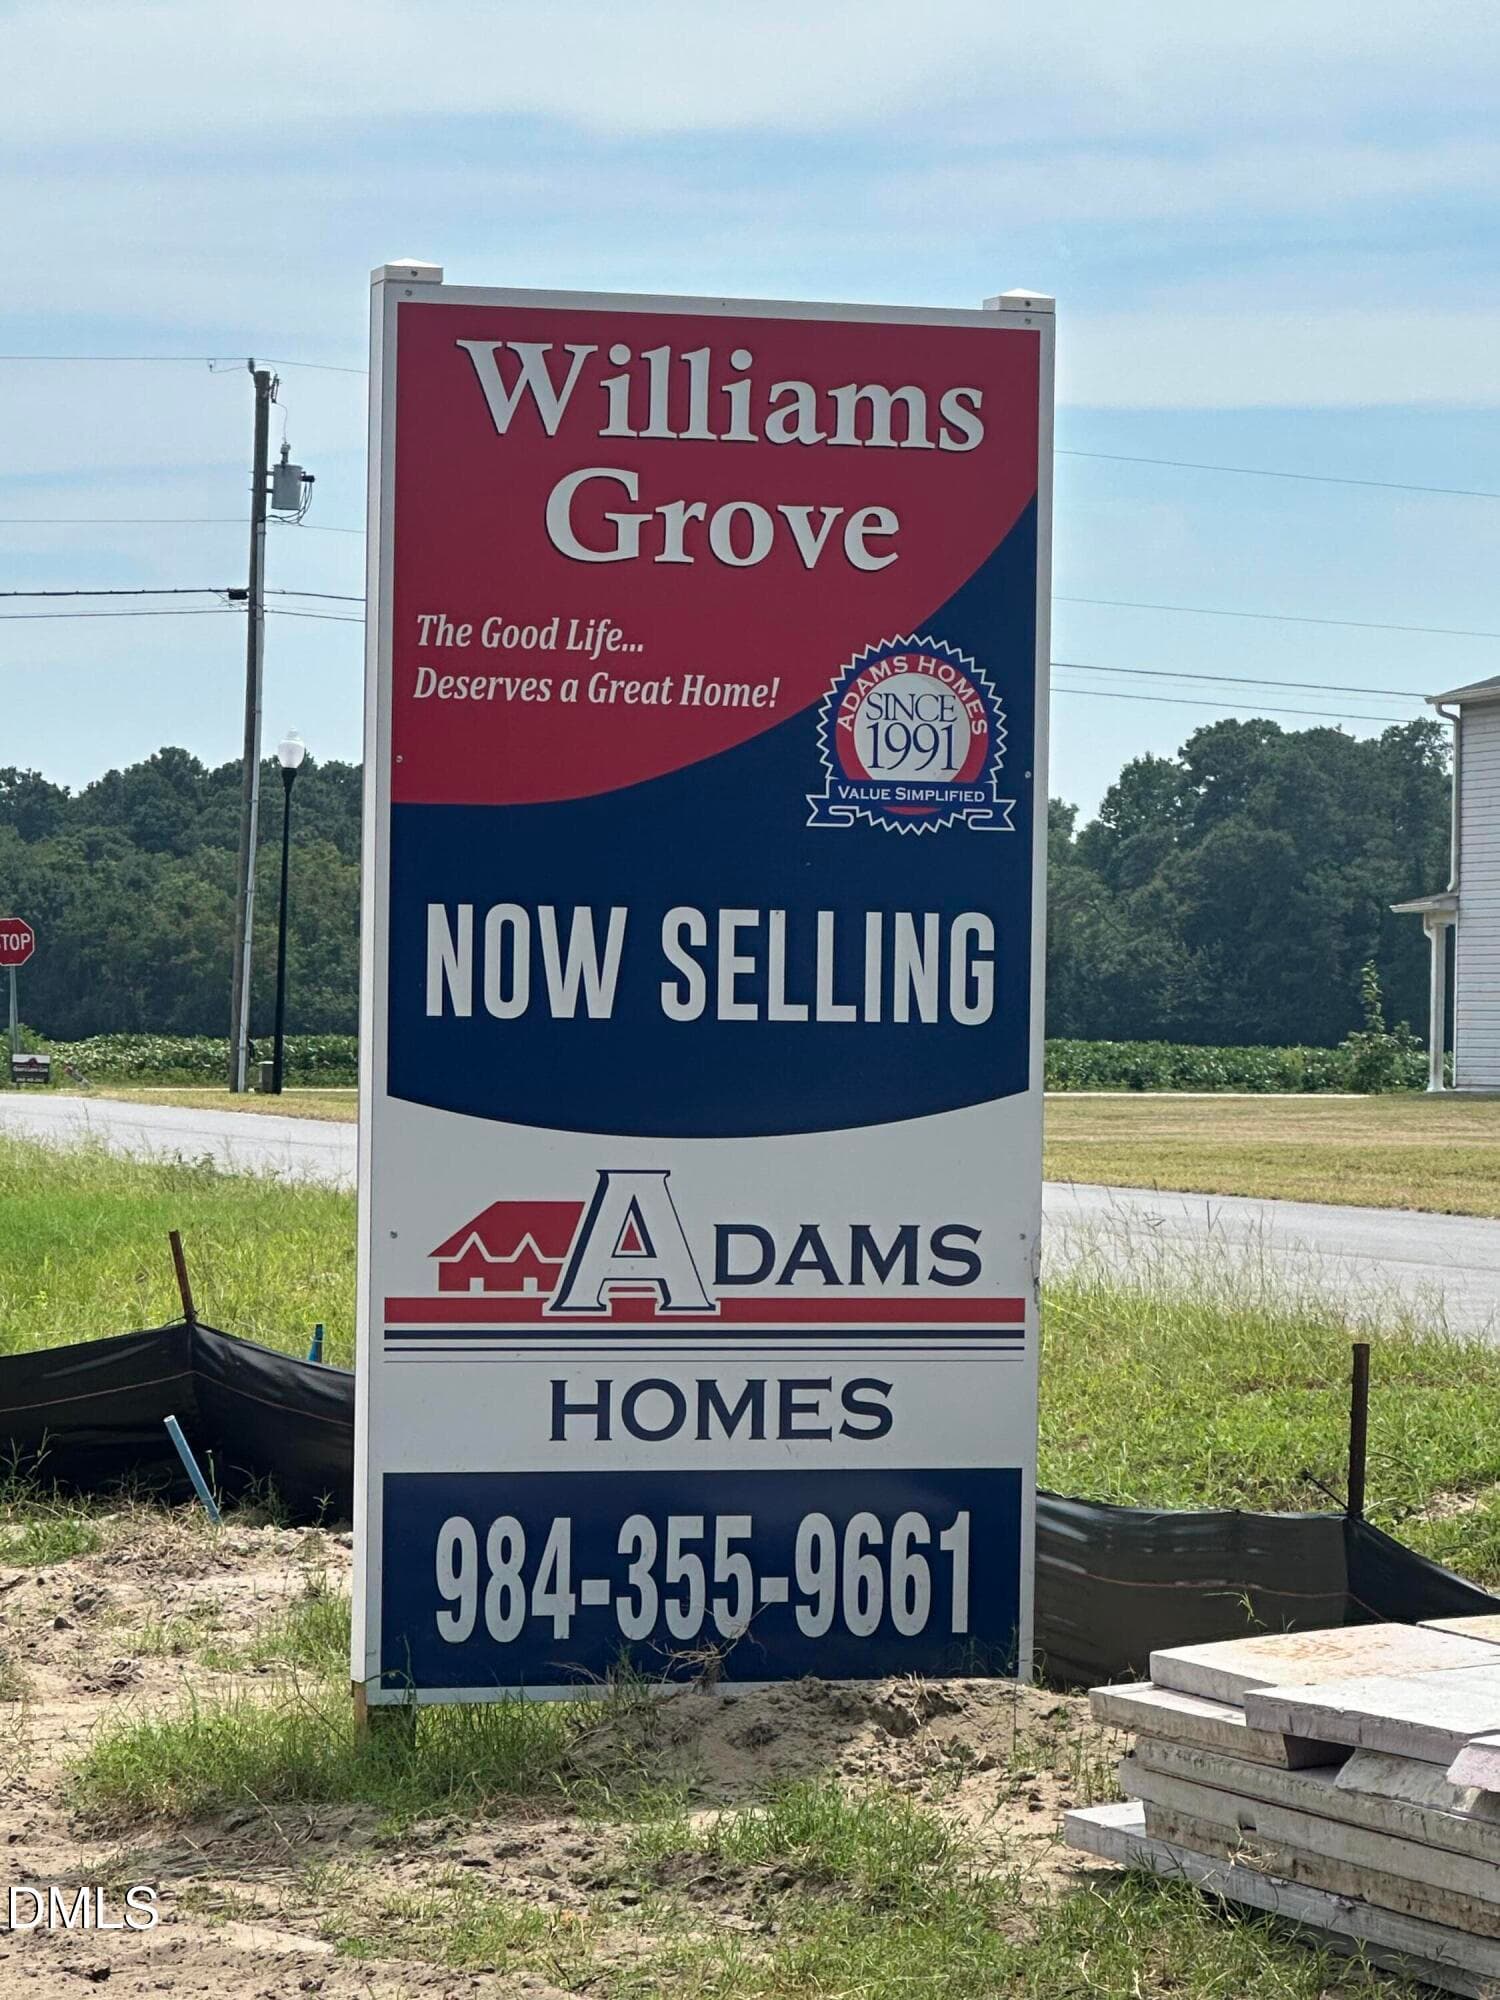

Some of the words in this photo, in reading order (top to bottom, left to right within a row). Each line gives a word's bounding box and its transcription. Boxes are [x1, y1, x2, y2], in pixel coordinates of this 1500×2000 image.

[456, 339, 986, 451] Williams
[545, 467, 899, 571] Grove
[417, 614, 473, 647] The
[481, 616, 560, 650] Good
[566, 619, 644, 660] Life...
[413, 667, 552, 702] Deserves
[560, 677, 579, 703] a
[588, 672, 673, 705] Great
[679, 674, 781, 708] Home!
[837, 655, 909, 732] ADAMS
[917, 655, 988, 735] HOMES
[866, 692, 958, 722] SINCE
[866, 722, 959, 771] 1991
[838, 786, 891, 801] VALUE
[895, 787, 985, 803] SIMPLIFIED
[0, 933, 31, 951] TOP
[425, 903, 628, 1020] NOW
[660, 906, 996, 1025] SELLING
[548, 1169, 983, 1313] ADAMS
[549, 1377, 895, 1441] HOMES
[435, 1510, 971, 1644] 984-355-9661
